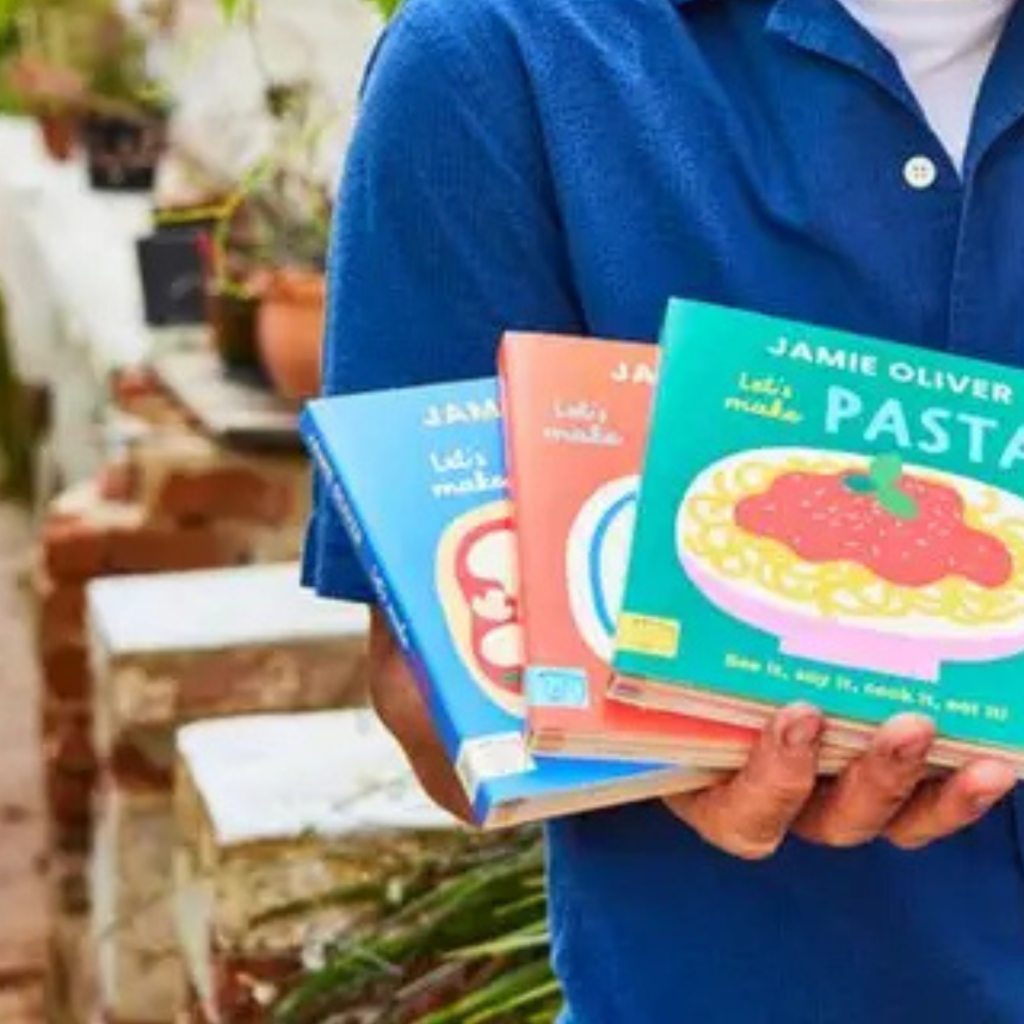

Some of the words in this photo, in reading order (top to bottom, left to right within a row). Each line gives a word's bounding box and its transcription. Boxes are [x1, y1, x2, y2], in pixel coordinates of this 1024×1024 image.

[767, 336, 878, 378] JAMIE
[888, 362, 1015, 405] OLIVER
[736, 372, 793, 400] Let's
[422, 397, 503, 427] JAM
[723, 394, 805, 425] make
[543, 425, 623, 447] make
[430, 471, 506, 498] make
